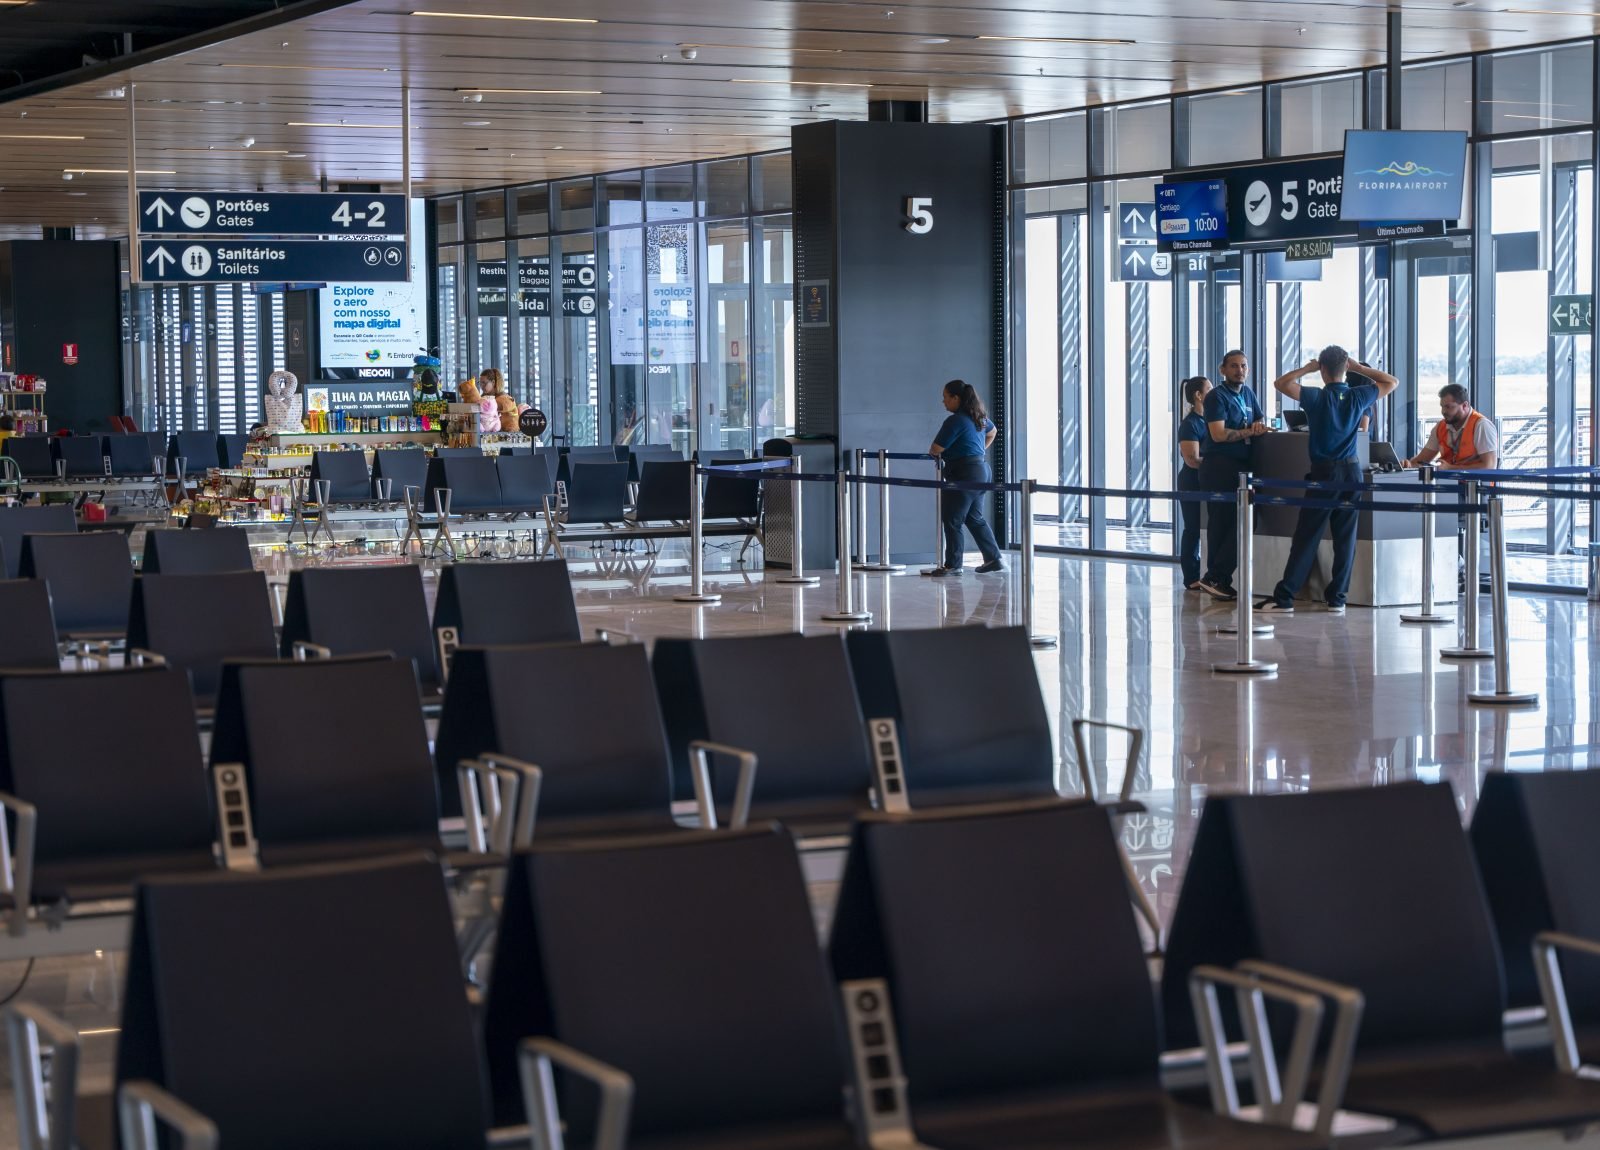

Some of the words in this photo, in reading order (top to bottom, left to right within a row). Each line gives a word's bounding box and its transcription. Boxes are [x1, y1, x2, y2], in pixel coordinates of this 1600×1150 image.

[1359, 182, 1402, 190] FLORIPA
[1404, 182, 1448, 190] AIRPORT
[216, 199, 270, 213] Portões
[1280, 181, 1299, 220] 5
[1159, 203, 1181, 212] Santiago
[1307, 201, 1338, 219] Gate
[331, 201, 386, 228] 4-2
[907, 197, 934, 235] 5
[216, 215, 254, 227] Gates
[1194, 217, 1218, 232] 10:00
[1377, 226, 1396, 236] Última
[1396, 225, 1424, 234] Chamada
[1189, 240, 1212, 249] Chamada
[1309, 240, 1332, 256] SAÍDA
[217, 248, 286, 260] Sanitários
[217, 262, 260, 275] Toilets
[526, 267, 537, 275] de
[520, 276, 550, 286] Baggag
[333, 286, 375, 297] Explore
[333, 298, 341, 306] o
[344, 298, 368, 306] aero
[518, 298, 544, 311] aída
[333, 309, 357, 317] com
[360, 309, 391, 317] nosso
[333, 320, 366, 330] mapa
[366, 318, 401, 330] digital
[358, 368, 391, 377] NEOOH
[331, 391, 356, 403] ILHA
[359, 391, 374, 402] DA
[376, 390, 411, 402] MAGIA
